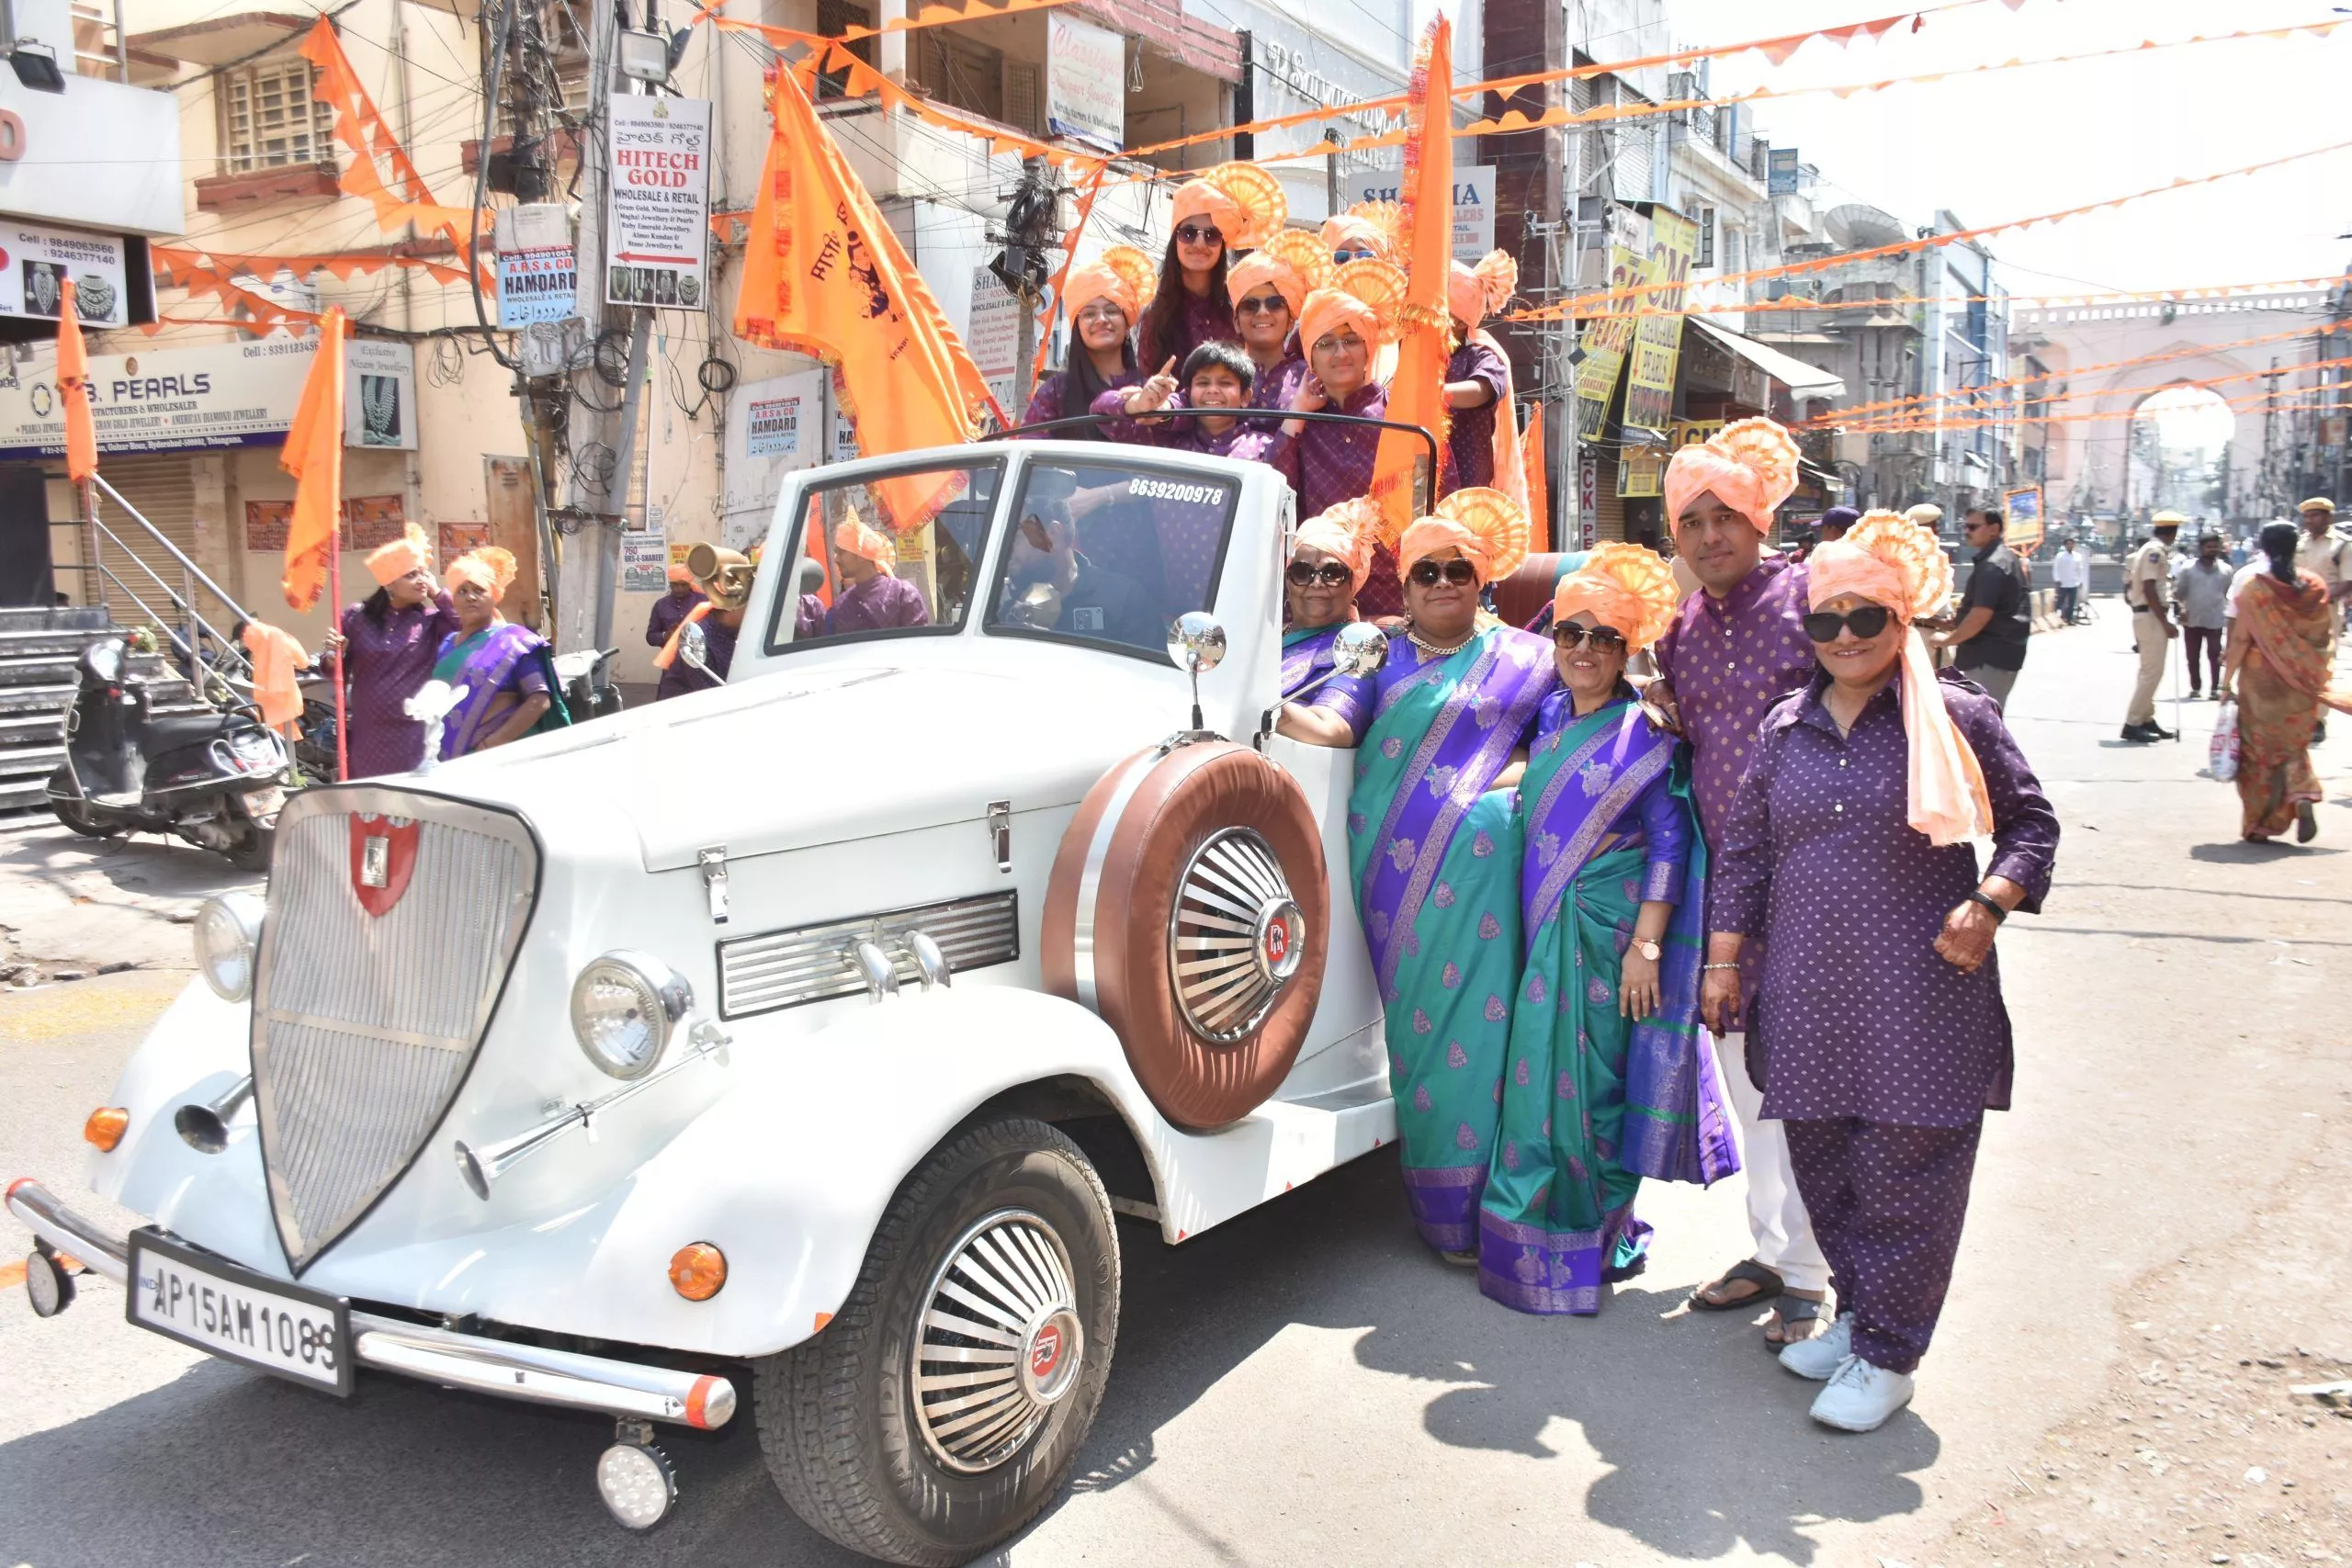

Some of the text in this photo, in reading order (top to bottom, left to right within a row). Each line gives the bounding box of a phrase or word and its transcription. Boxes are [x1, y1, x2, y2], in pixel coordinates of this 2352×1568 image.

[617, 150, 699, 170] HITECH
[628, 169, 687, 187] GOLD
[614, 188, 698, 204] WHOLESALE & RETAIL
[18, 233, 40, 244] Cell
[50, 238, 115, 254] 9849063560
[51, 249, 115, 265] 9246377140
[503, 254, 523, 262] Cell:
[1453, 249, 1484, 257] ELENGANA
[544, 261, 551, 270] &
[556, 257, 572, 269] CO
[505, 272, 577, 294] HAMDARD
[507, 294, 547, 303] WHOLESALE
[971, 300, 1000, 312] WHOLESALE
[243, 347, 261, 357] Cell
[112, 373, 211, 402] PEARLS
[92, 400, 198, 417] UFACTURERS & WHOLESALER
[21, 423, 41, 434] PEARLS
[42, 422, 67, 434] JEWELLE
[130, 416, 162, 428] JEWELLERY
[172, 412, 201, 425] AMERICAN
[203, 410, 231, 423] DIAMOND
[232, 408, 267, 421] JEWELLERY
[752, 416, 797, 434] HAMDARD
[1128, 478, 1223, 505] 8639200978
[140, 1276, 157, 1291] IND
